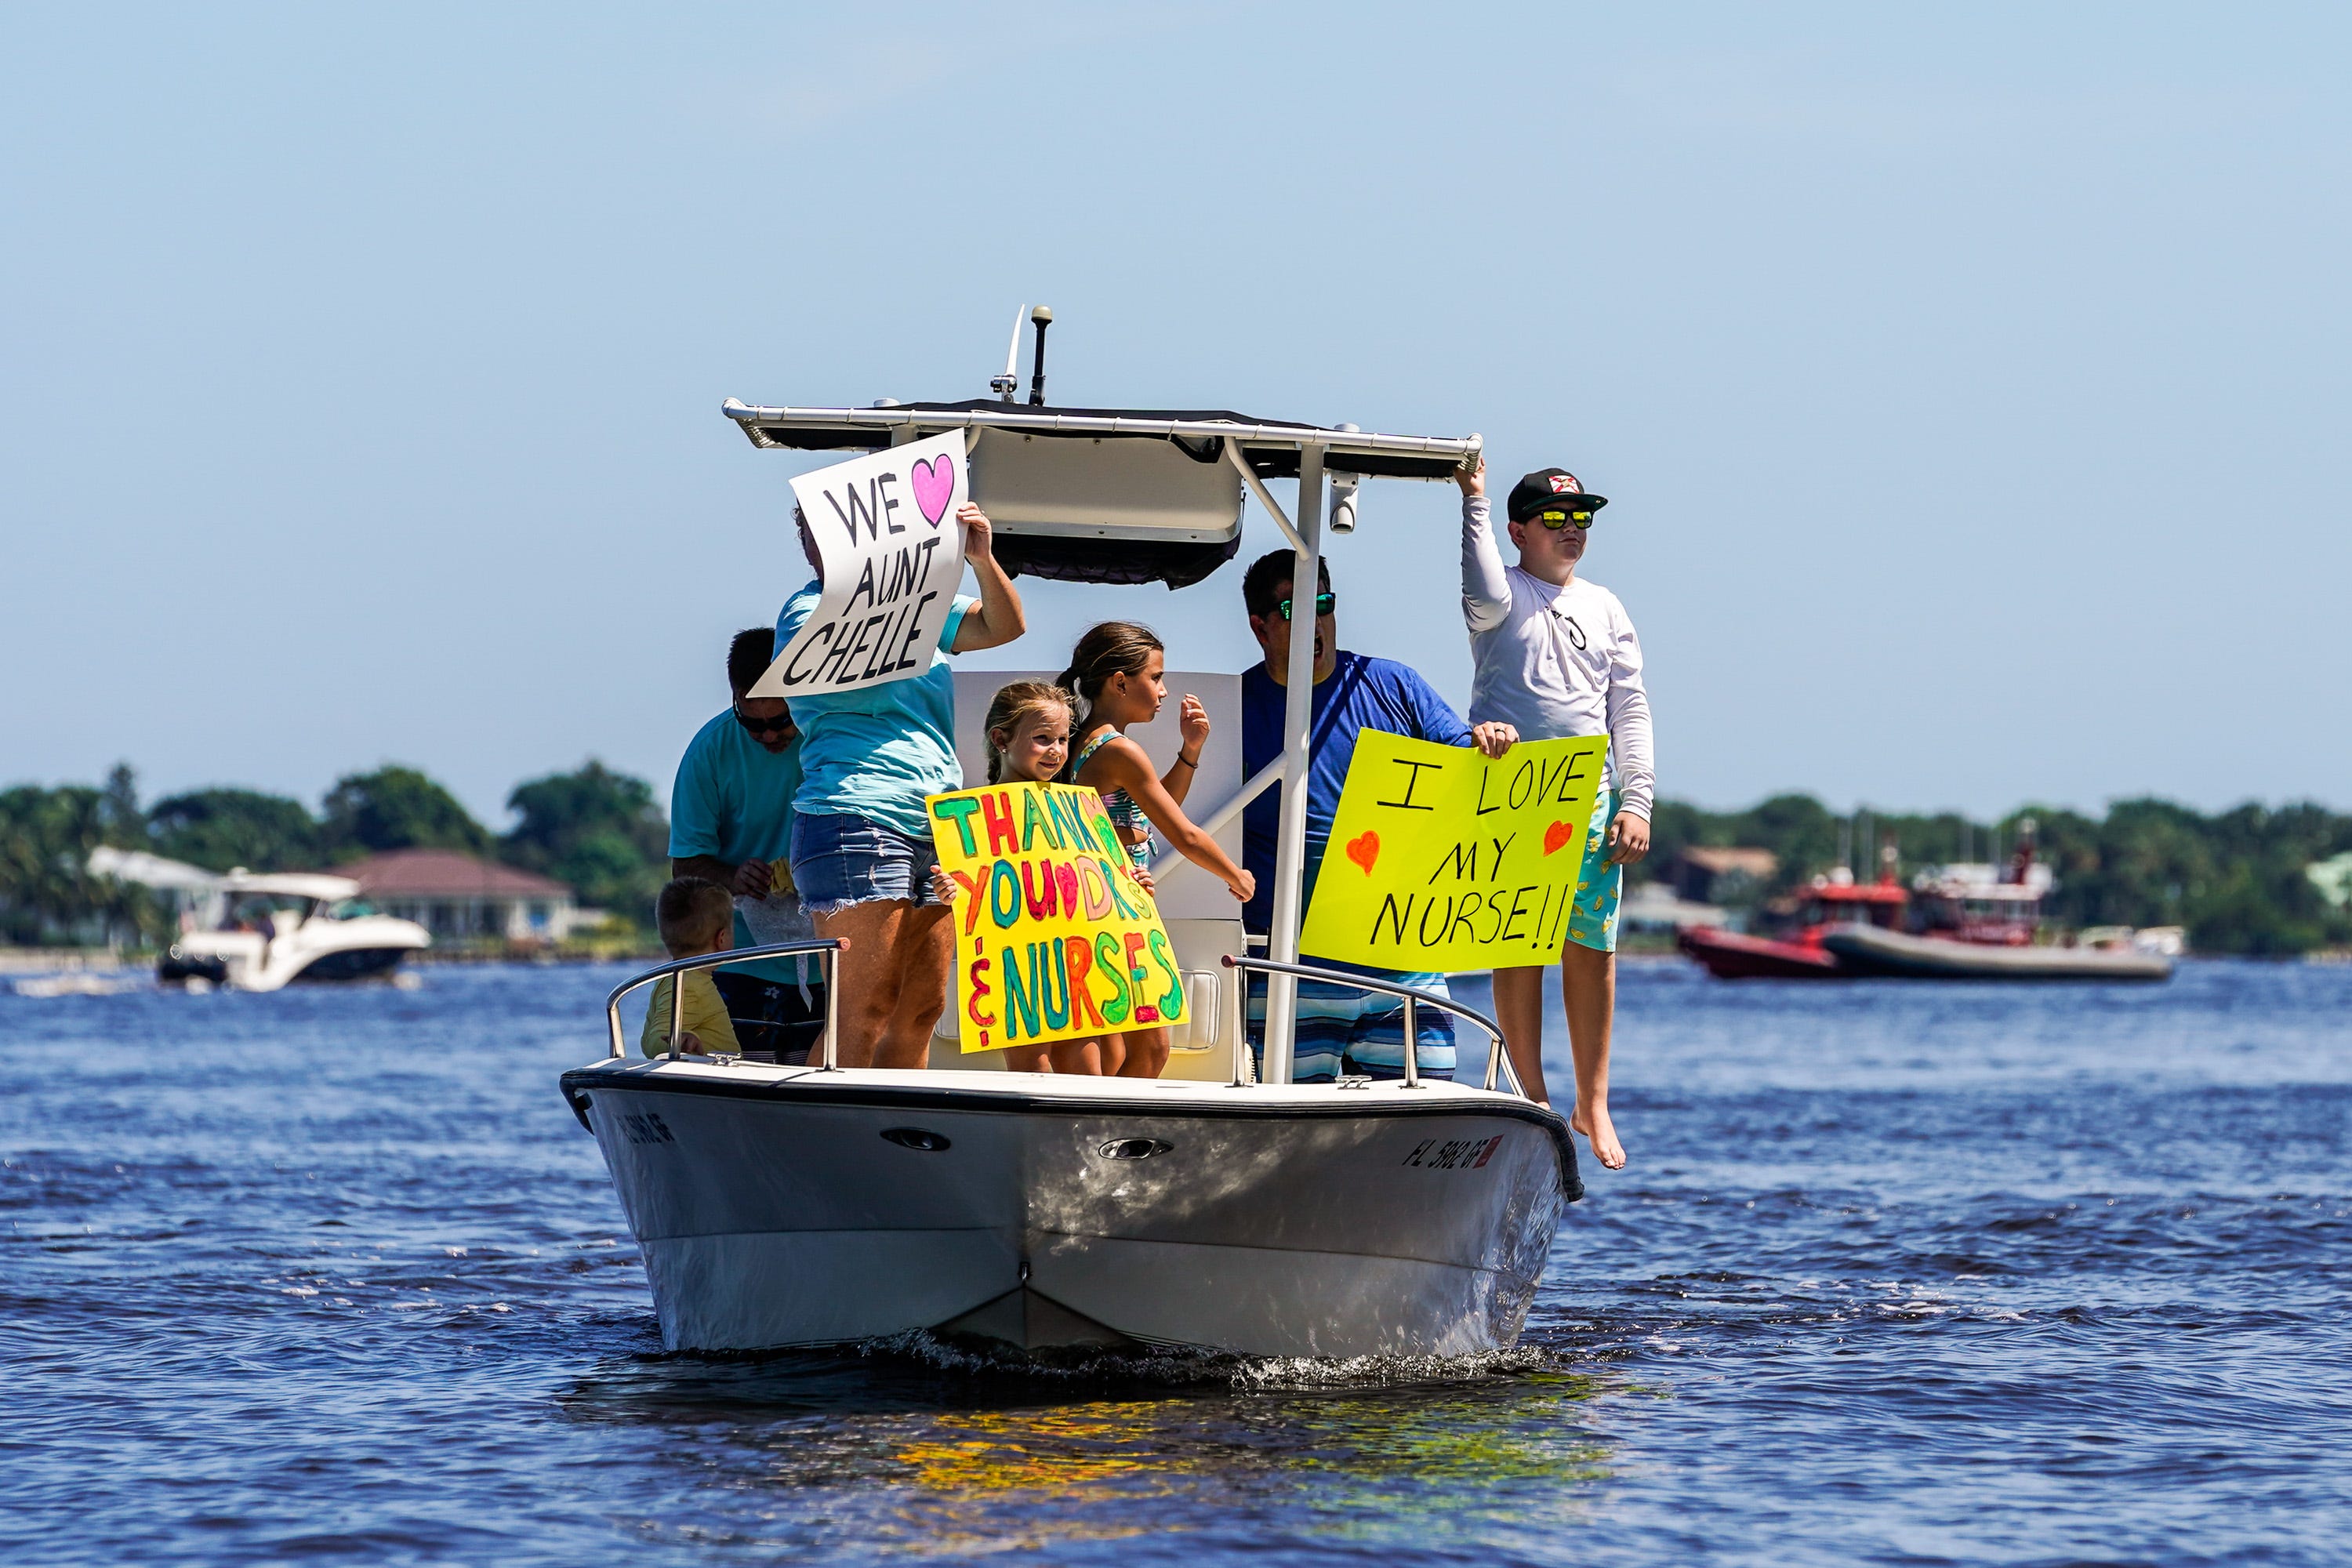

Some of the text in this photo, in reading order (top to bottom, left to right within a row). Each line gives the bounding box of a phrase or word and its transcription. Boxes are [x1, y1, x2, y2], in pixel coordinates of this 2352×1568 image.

[822, 472, 906, 548] WE
[842, 536, 941, 617] AUNT
[782, 590, 938, 686] CHELLE
[1376, 750, 1594, 816] I LOVE
[932, 788, 1102, 858] THANK
[1428, 831, 1517, 885] MY
[949, 854, 1152, 936] YOU DRS
[1370, 883, 1569, 950] NURSE!!
[1001, 928, 1183, 1040] NURSES
[1402, 1139, 1437, 1167] FL
[1427, 1141, 1472, 1170] 5962
